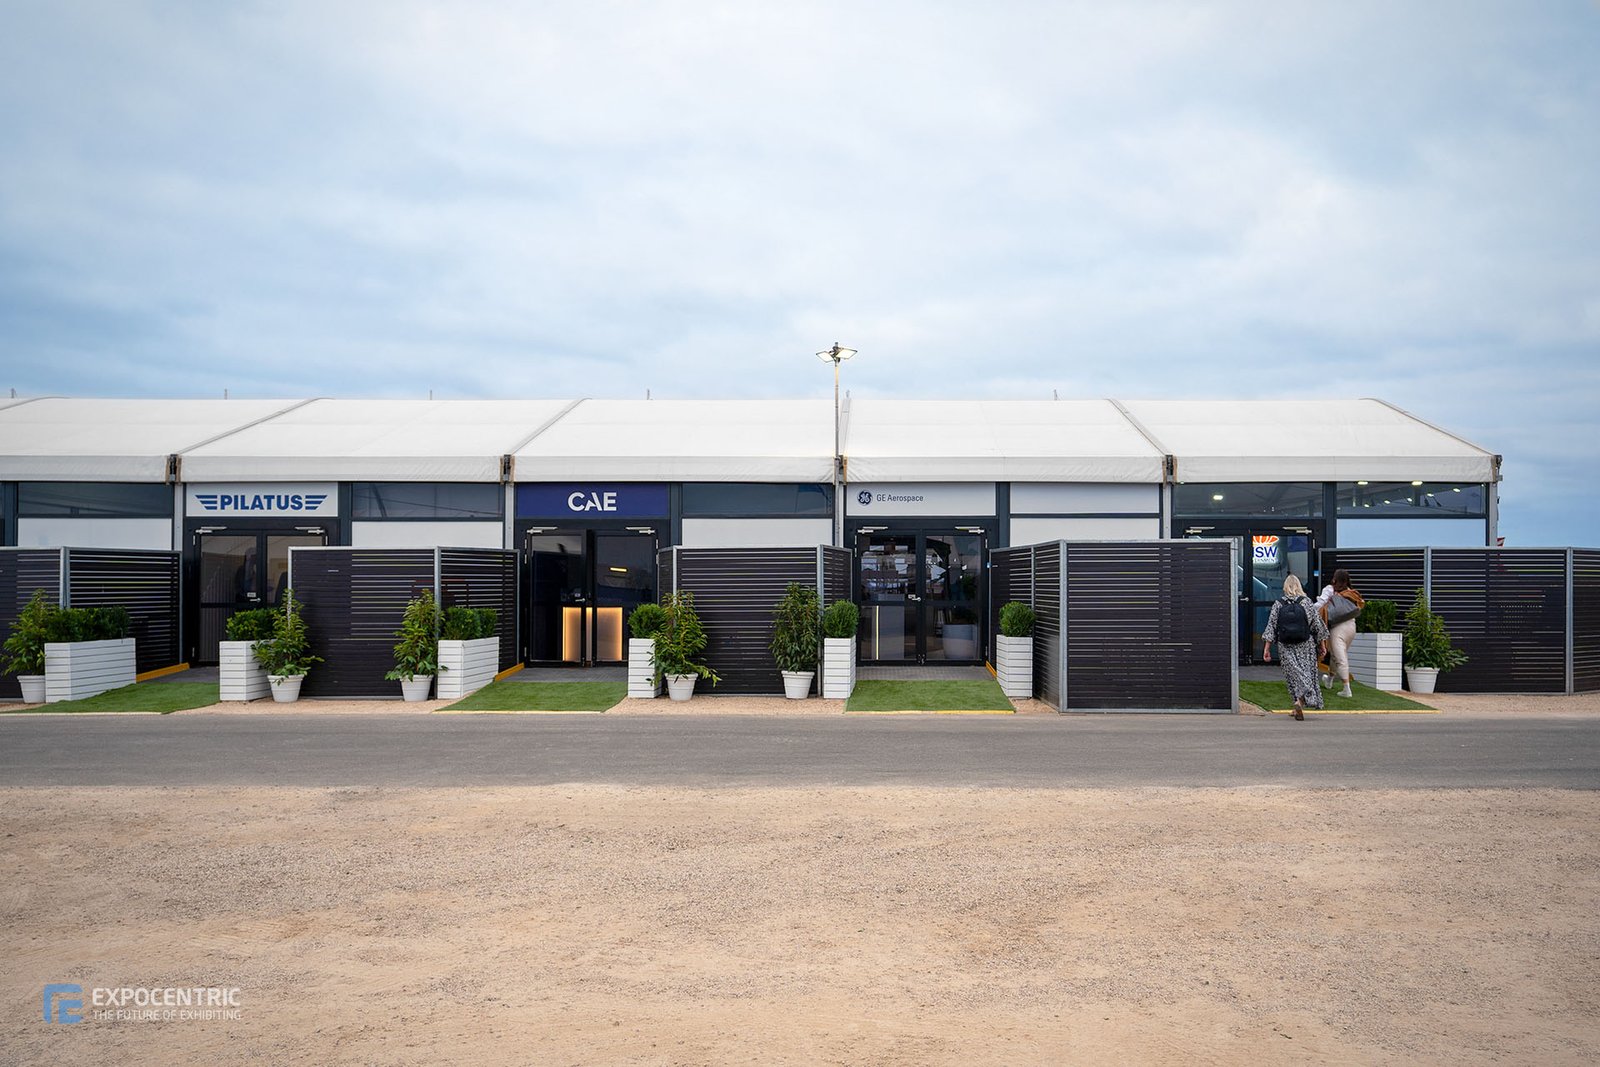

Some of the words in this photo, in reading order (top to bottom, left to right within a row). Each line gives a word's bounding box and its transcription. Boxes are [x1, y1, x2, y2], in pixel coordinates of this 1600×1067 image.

[220, 494, 303, 510] PILATUS
[567, 492, 617, 511] CAE
[876, 493, 886, 502] GE
[887, 493, 923, 503] Aerospace
[1252, 546, 1278, 558] SW
